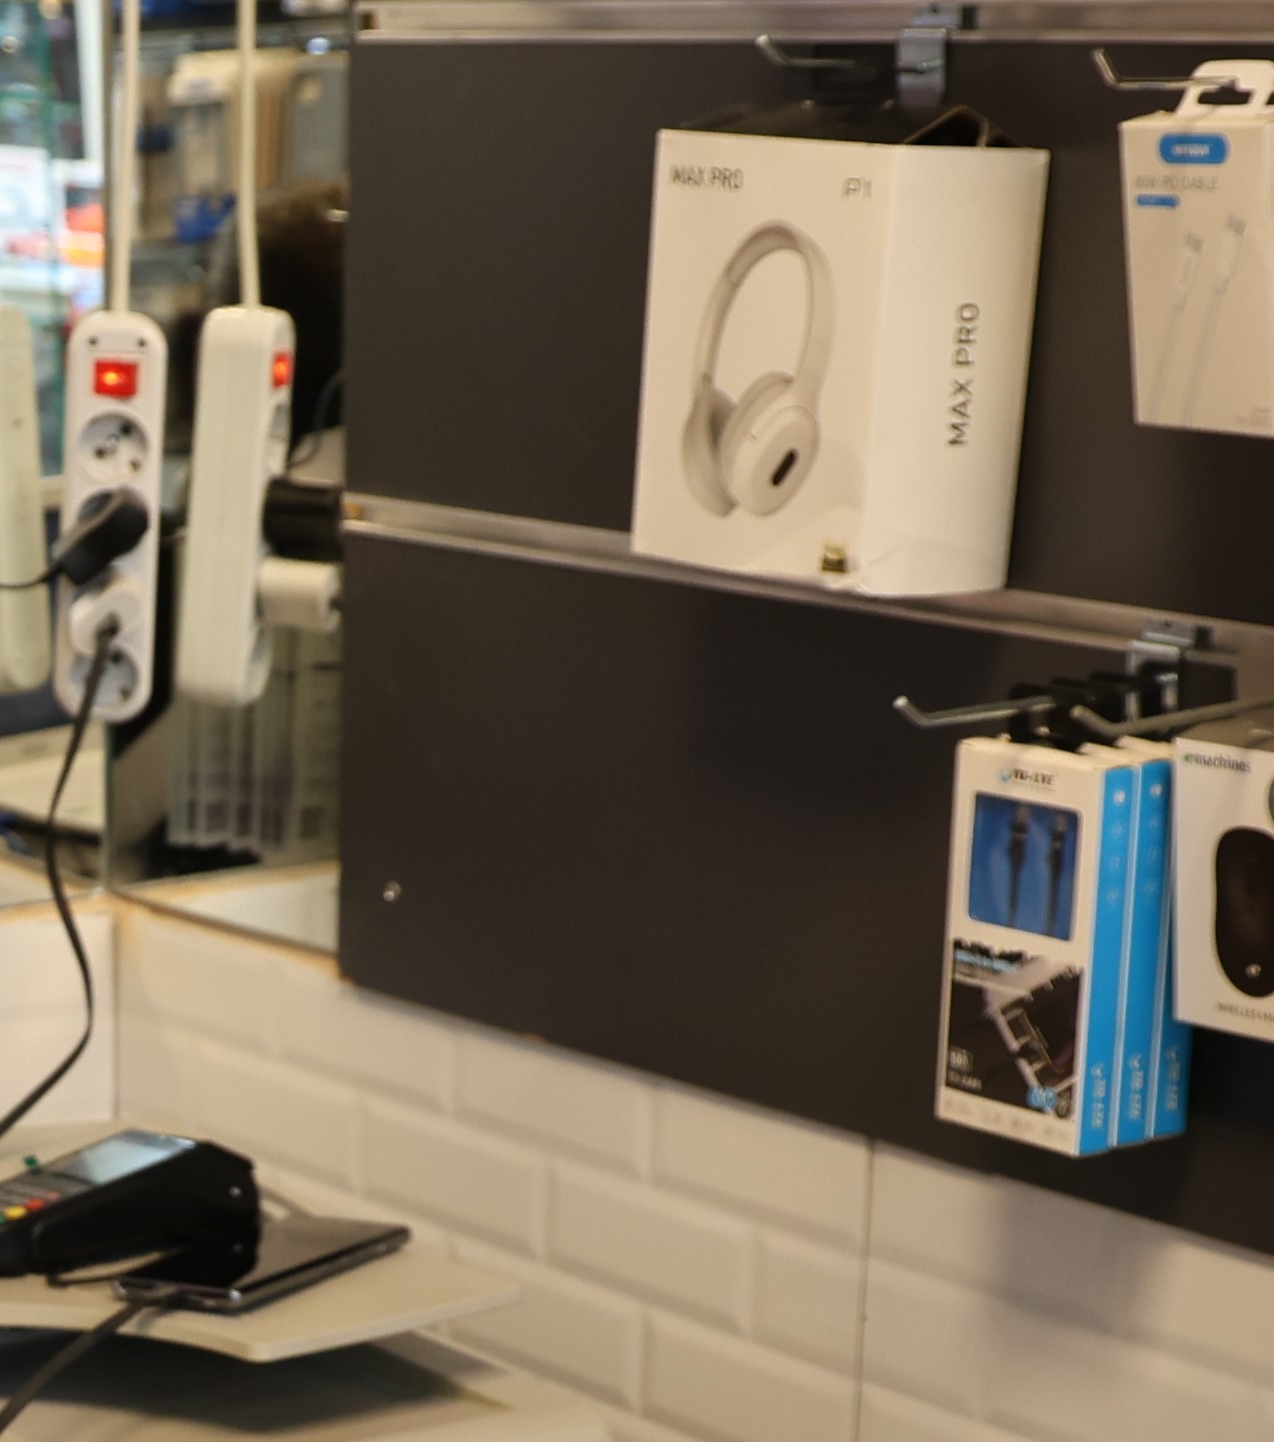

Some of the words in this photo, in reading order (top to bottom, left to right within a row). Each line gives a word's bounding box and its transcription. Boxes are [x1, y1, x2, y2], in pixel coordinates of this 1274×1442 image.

[670, 166, 707, 186] MAX
[710, 167, 744, 190] PRO
[955, 302, 981, 365] PRO
[948, 379, 973, 446] MAX
